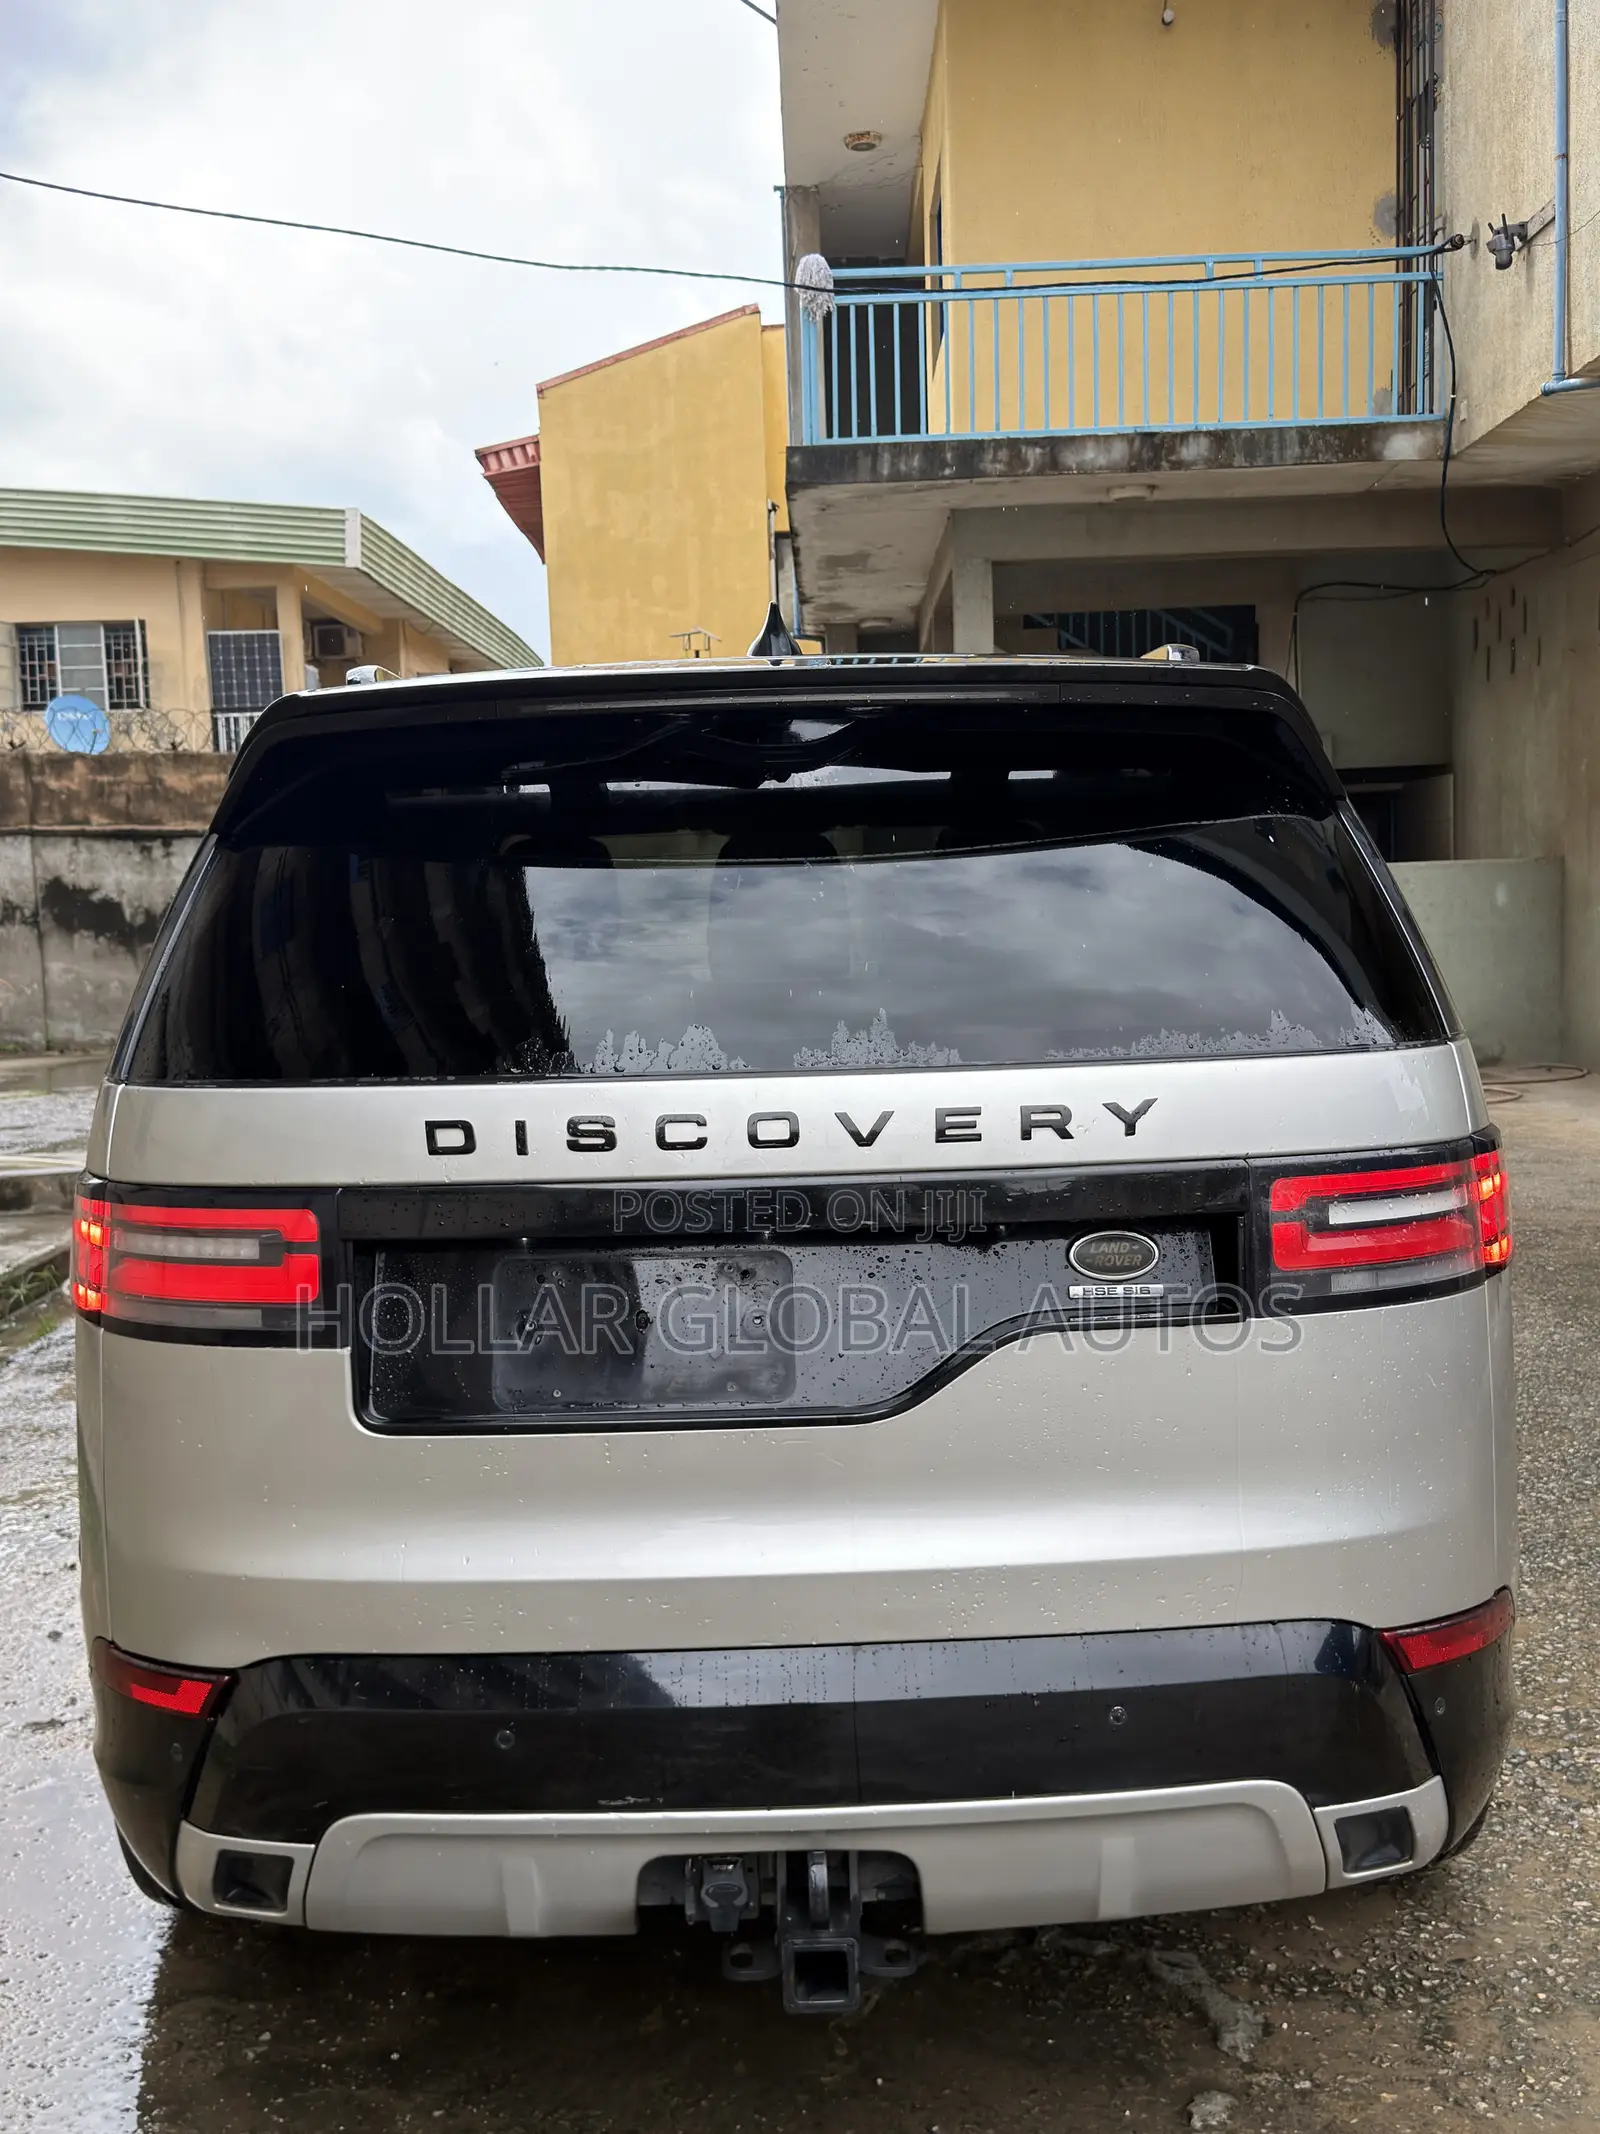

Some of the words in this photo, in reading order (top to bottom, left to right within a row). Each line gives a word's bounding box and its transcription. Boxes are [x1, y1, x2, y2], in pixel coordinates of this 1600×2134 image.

[424, 1097, 1158, 1156] DISCOVERY
[1090, 1242, 1131, 1254] LAND
[1095, 1254, 1143, 1267] ROVER
[1082, 1286, 1118, 1296] HSE
